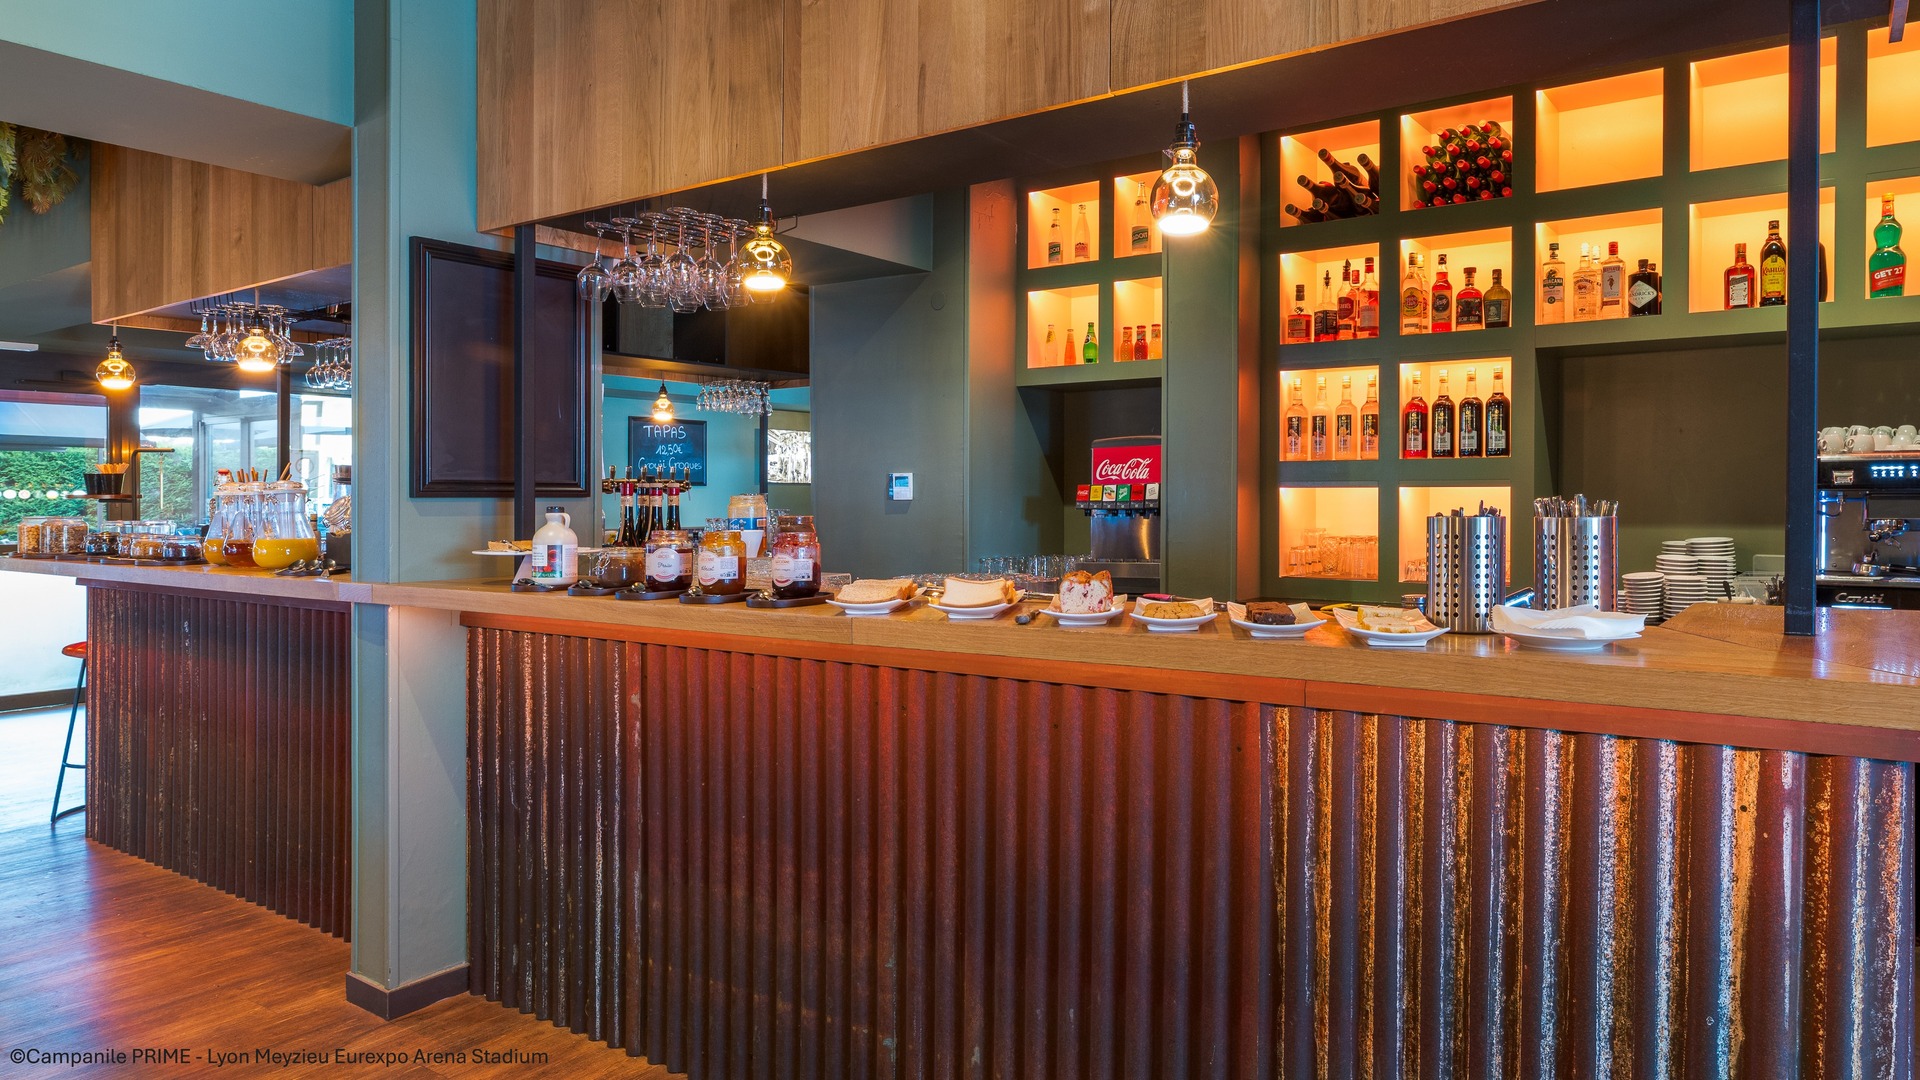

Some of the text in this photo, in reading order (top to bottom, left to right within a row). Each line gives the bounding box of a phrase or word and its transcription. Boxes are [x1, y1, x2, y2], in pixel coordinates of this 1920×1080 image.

[1874, 266, 1904, 280] GET 27
[643, 424, 687, 439] TAPAS
[655, 443, 683, 456] 12,50€
[1096, 457, 1153, 480] Coca-Cola
[1834, 592, 1885, 604] Conti
